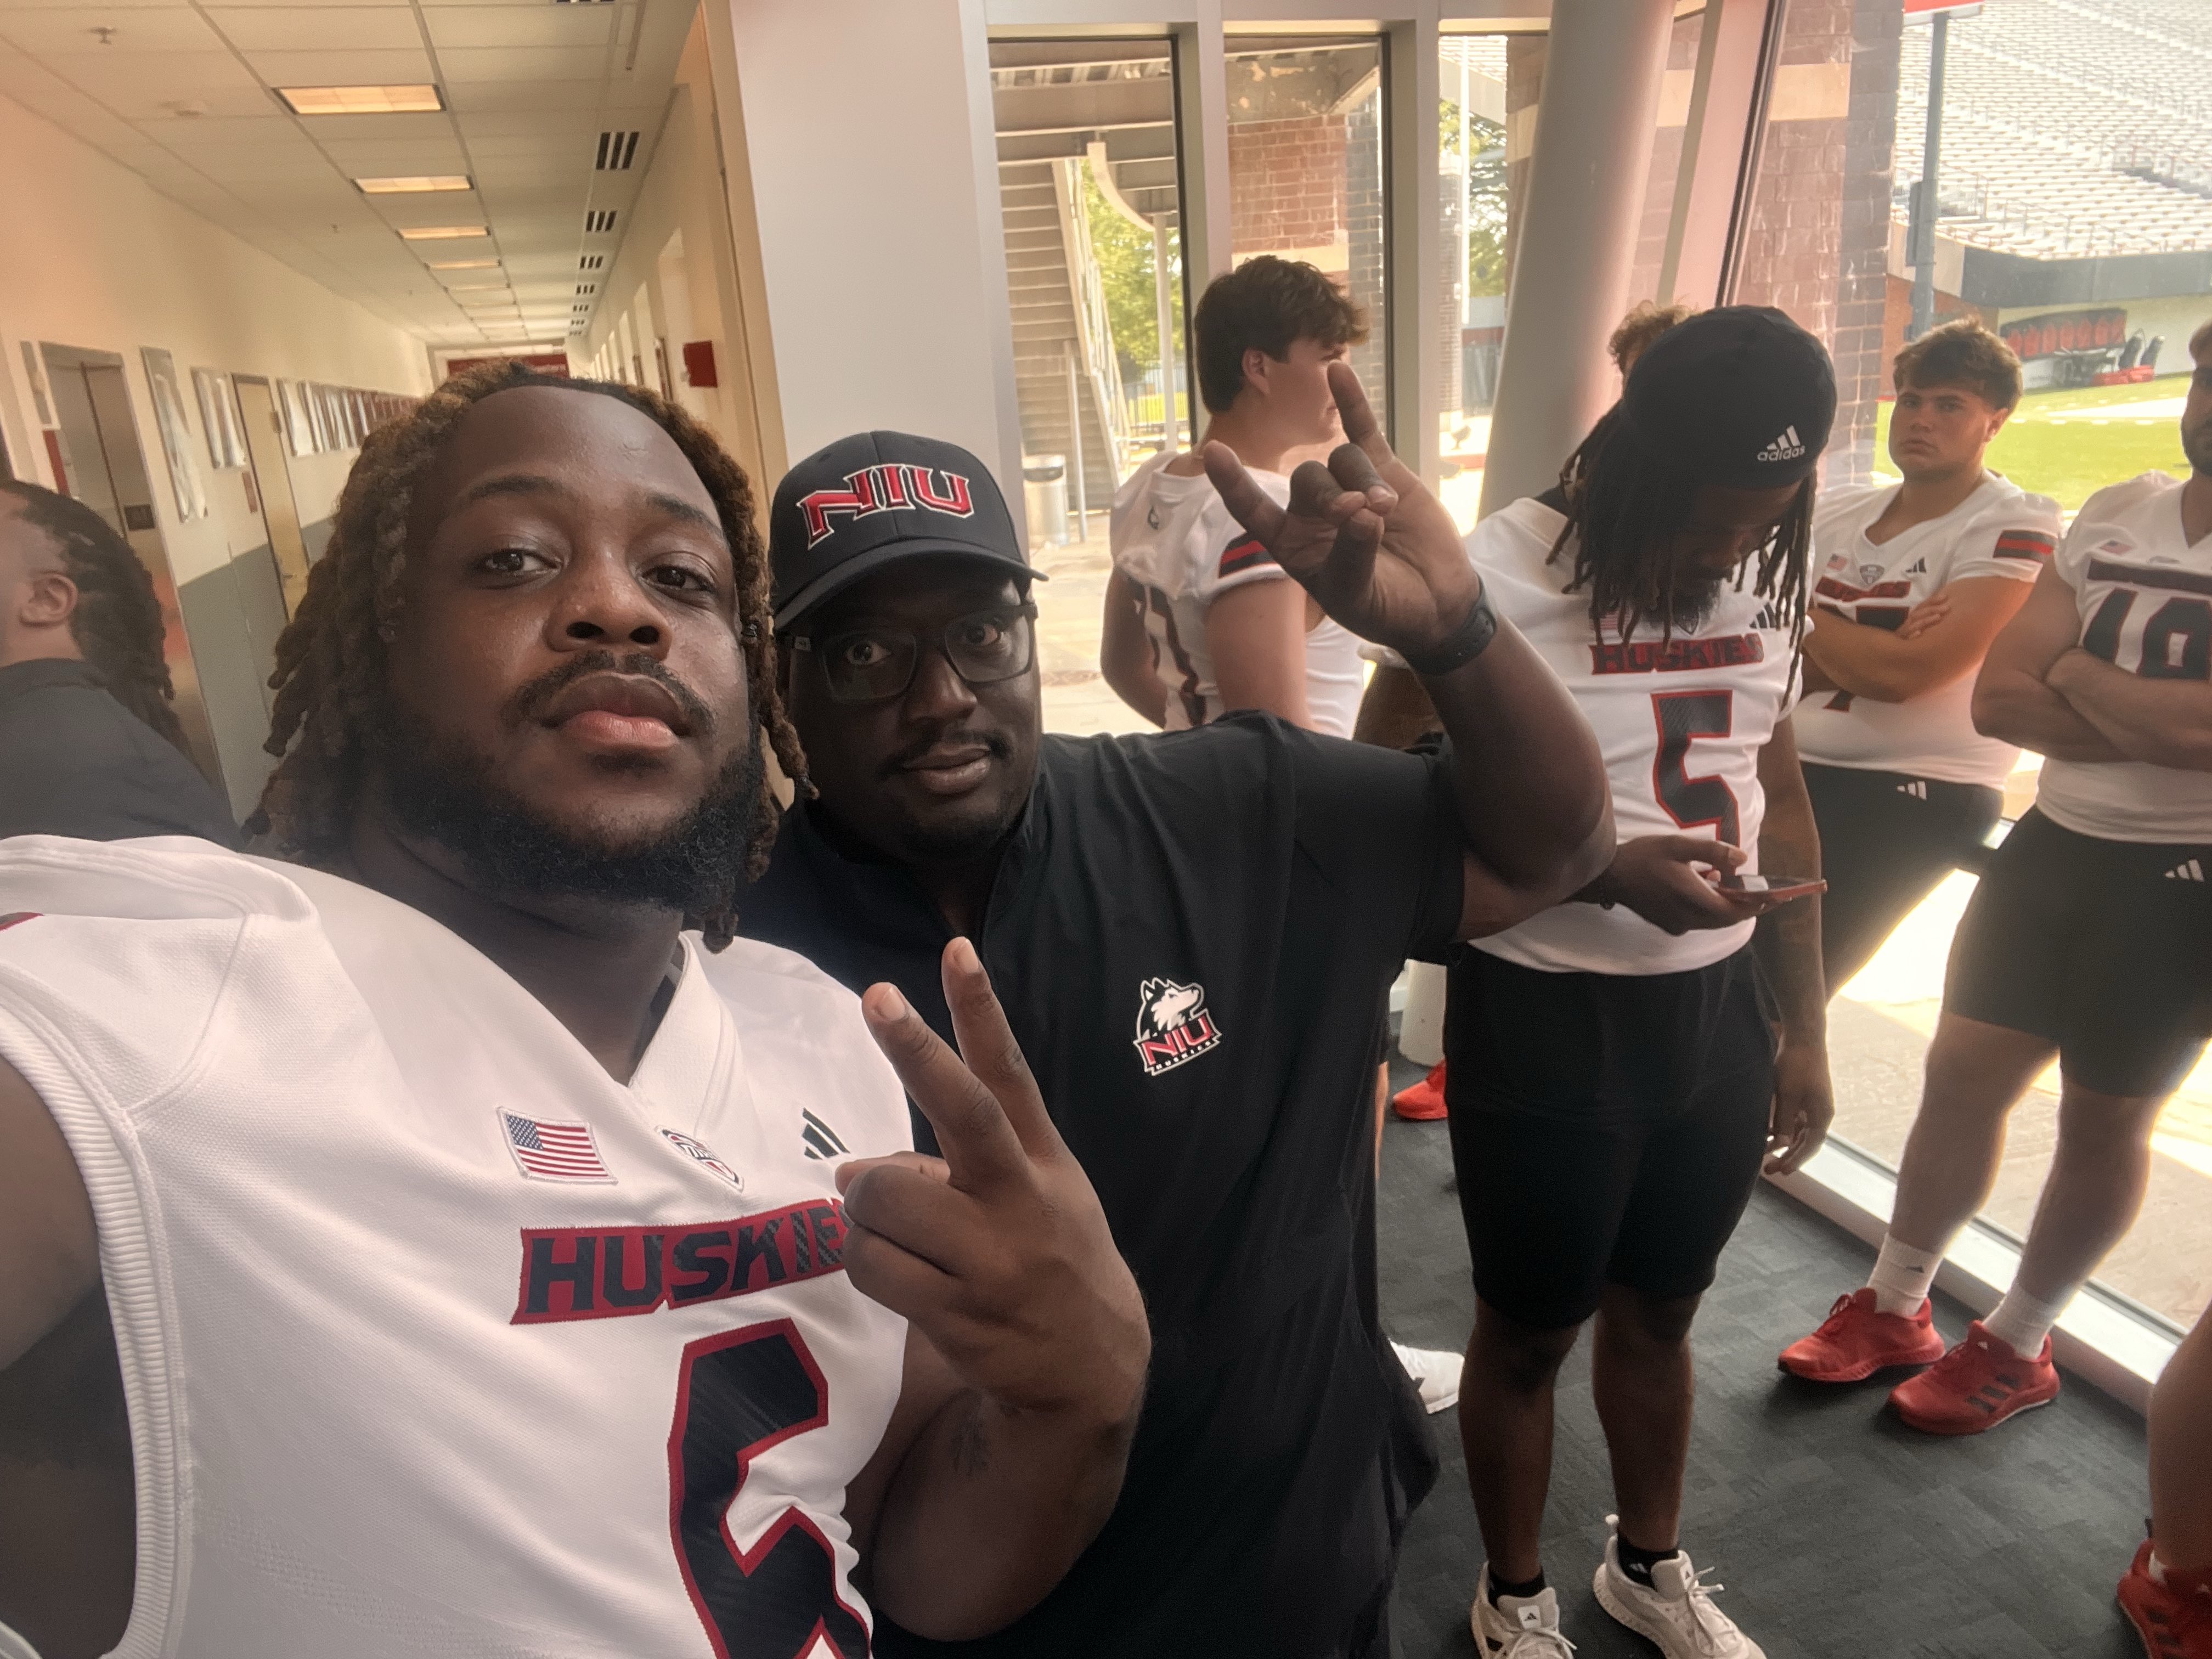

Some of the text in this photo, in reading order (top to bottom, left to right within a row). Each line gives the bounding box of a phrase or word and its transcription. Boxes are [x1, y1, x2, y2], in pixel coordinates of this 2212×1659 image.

[1757, 445, 1805, 461] adidas
[797, 464, 974, 550] NIU
[1650, 689, 1740, 848] 5
[1142, 1015, 1212, 1065] NIU
